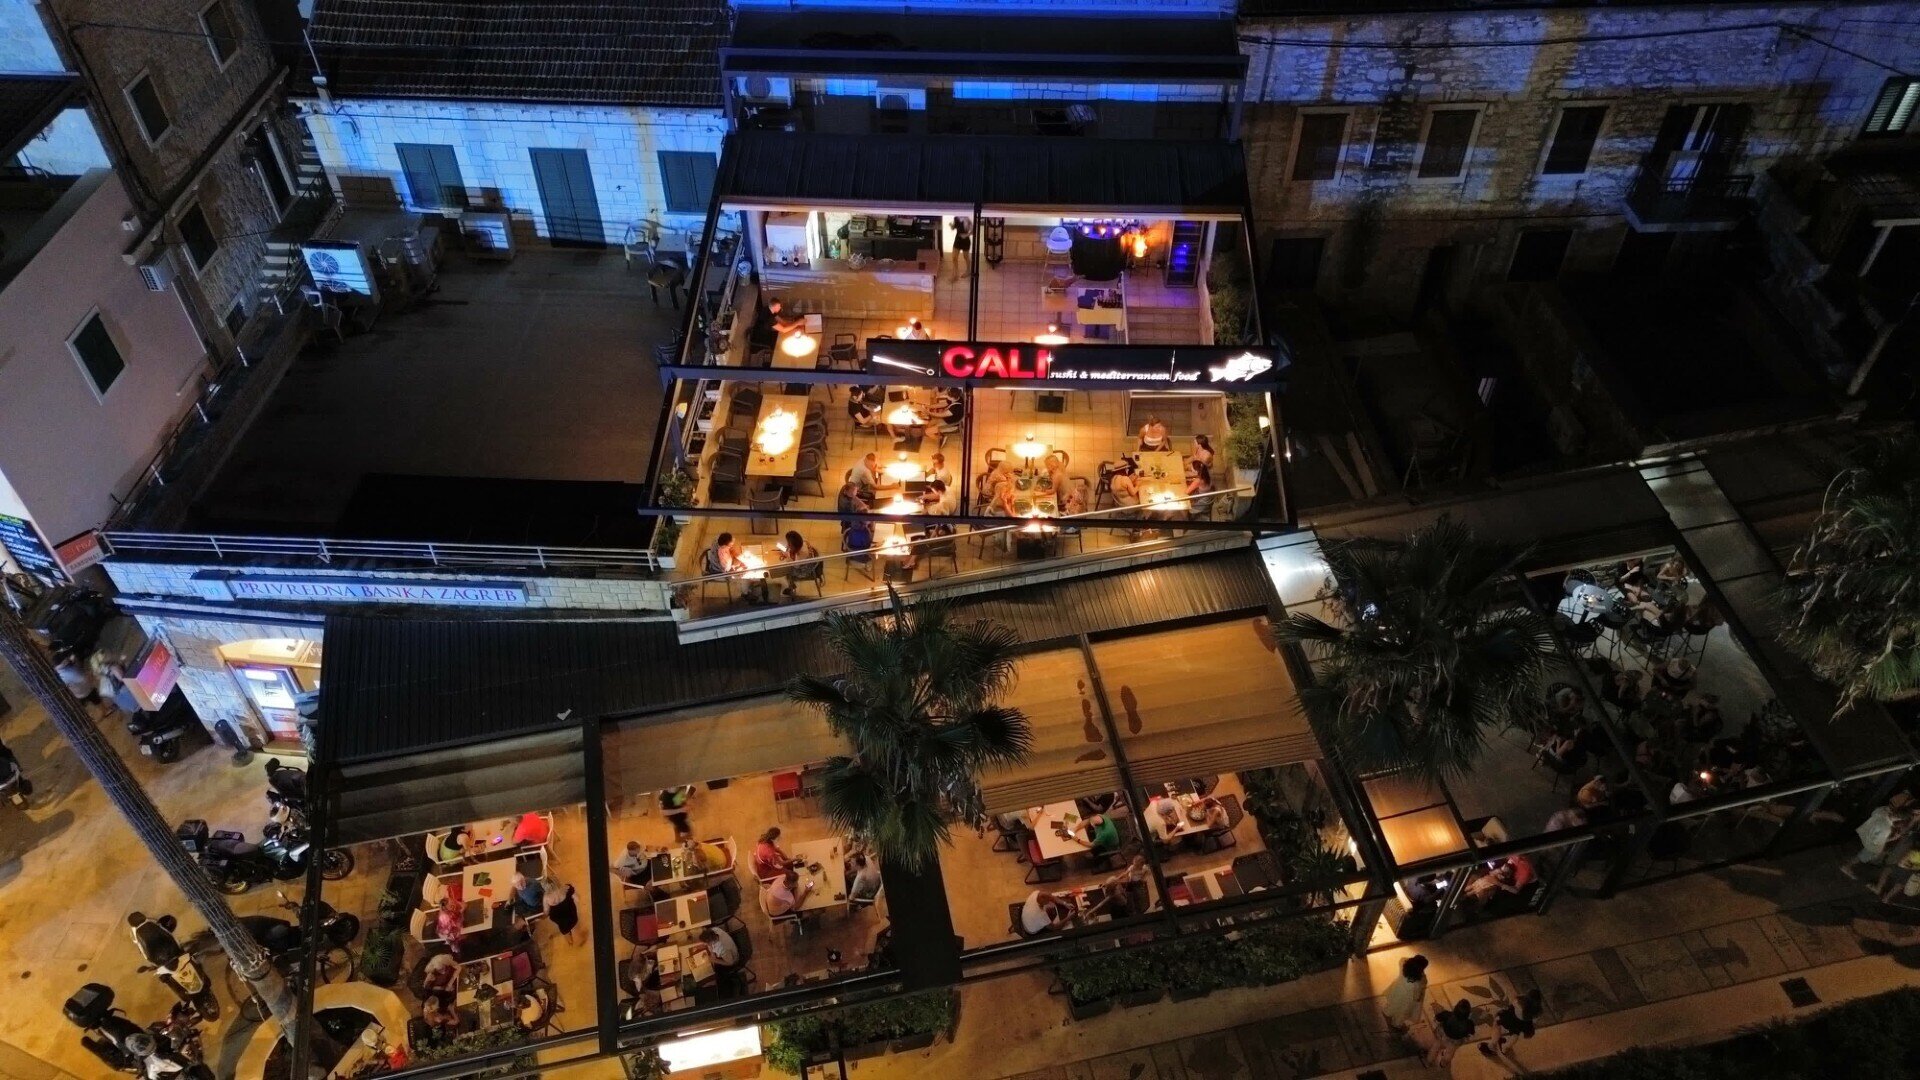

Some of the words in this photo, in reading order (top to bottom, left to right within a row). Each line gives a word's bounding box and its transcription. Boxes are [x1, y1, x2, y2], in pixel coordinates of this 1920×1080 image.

[943, 346, 1048, 378] CALI
[1050, 369, 1078, 379] sushi
[1079, 370, 1088, 379] &
[1090, 369, 1170, 380] mediterranean
[1171, 370, 1201, 382] food
[238, 582, 356, 597] PRIVREDNA
[361, 585, 434, 599] BANKA
[437, 587, 517, 602] ZAGREB
